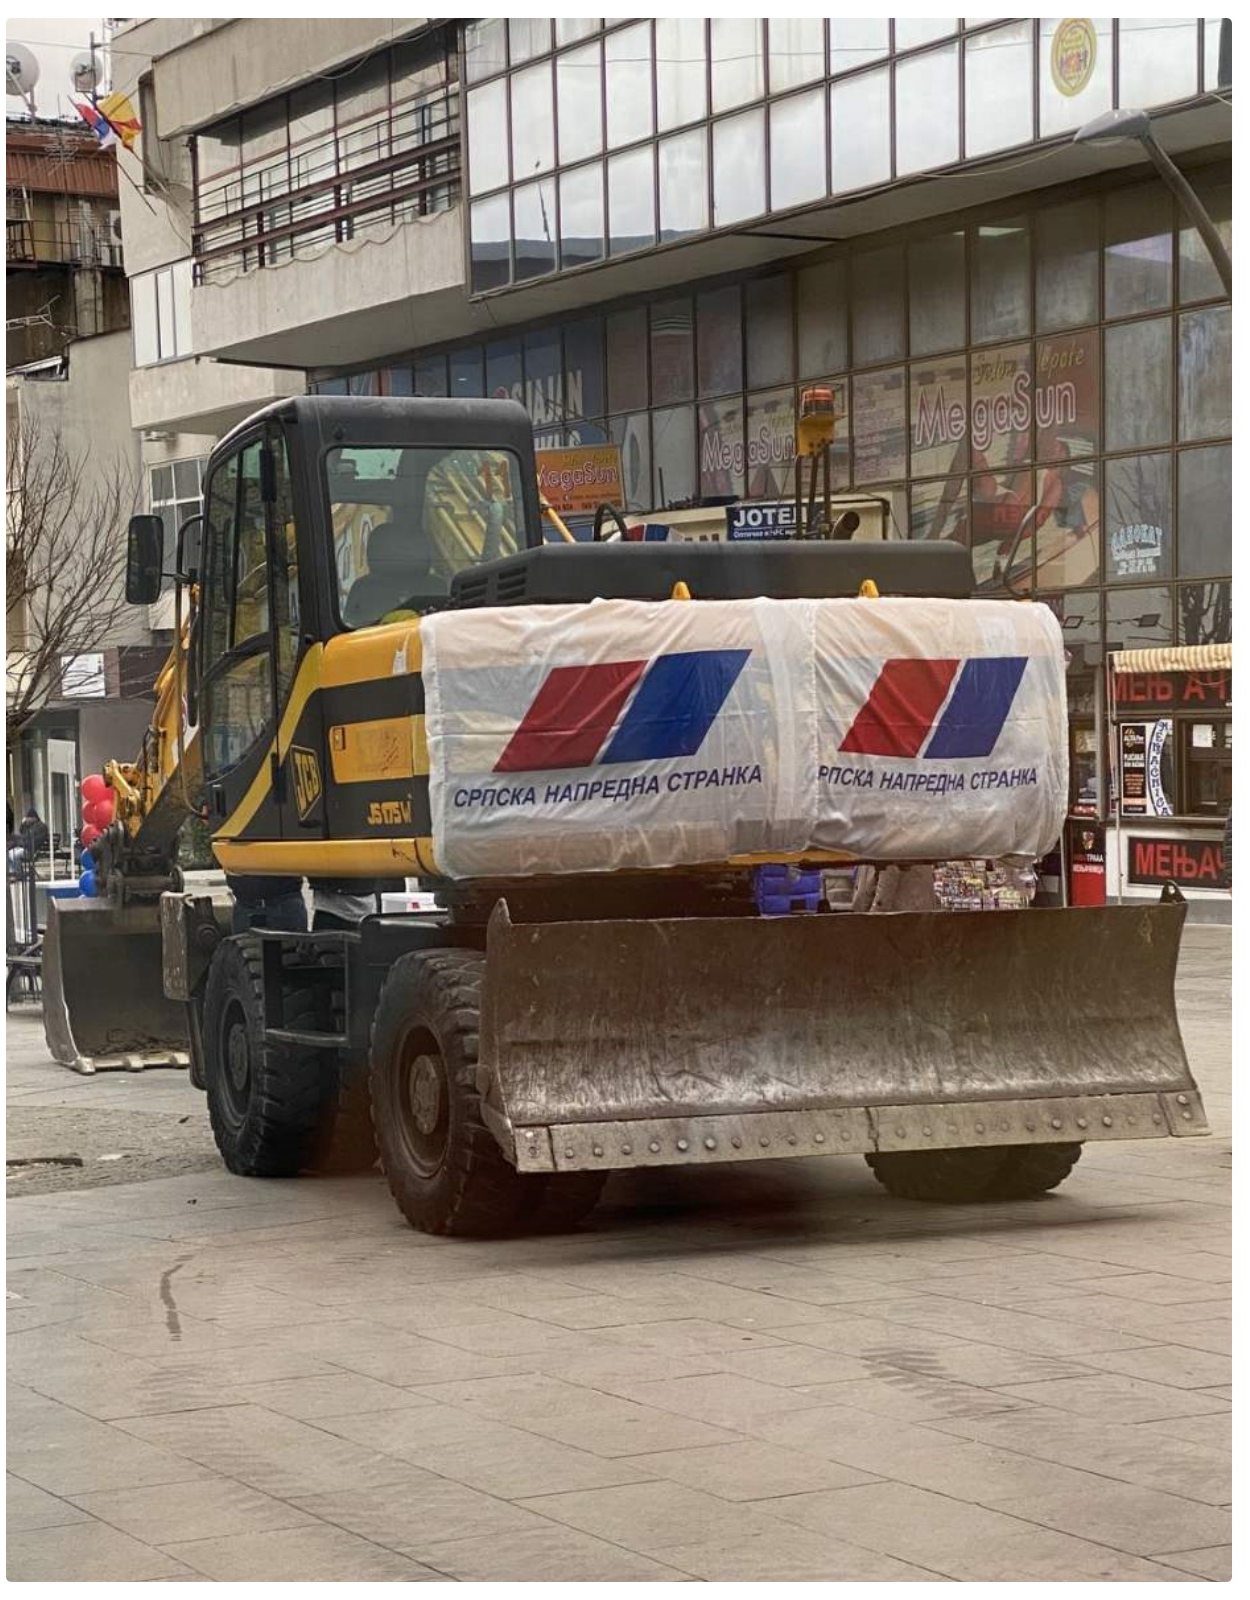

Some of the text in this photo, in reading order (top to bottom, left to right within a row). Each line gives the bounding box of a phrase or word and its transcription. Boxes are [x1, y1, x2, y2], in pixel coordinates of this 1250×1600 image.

[914, 371, 1077, 451] MegaSun
[453, 764, 763, 807] СРПСКА НАПРЕДНА СТРАНКА
[879, 771, 965, 795] НАПРЕДНА
[969, 767, 1038, 790] СТРАНКА
